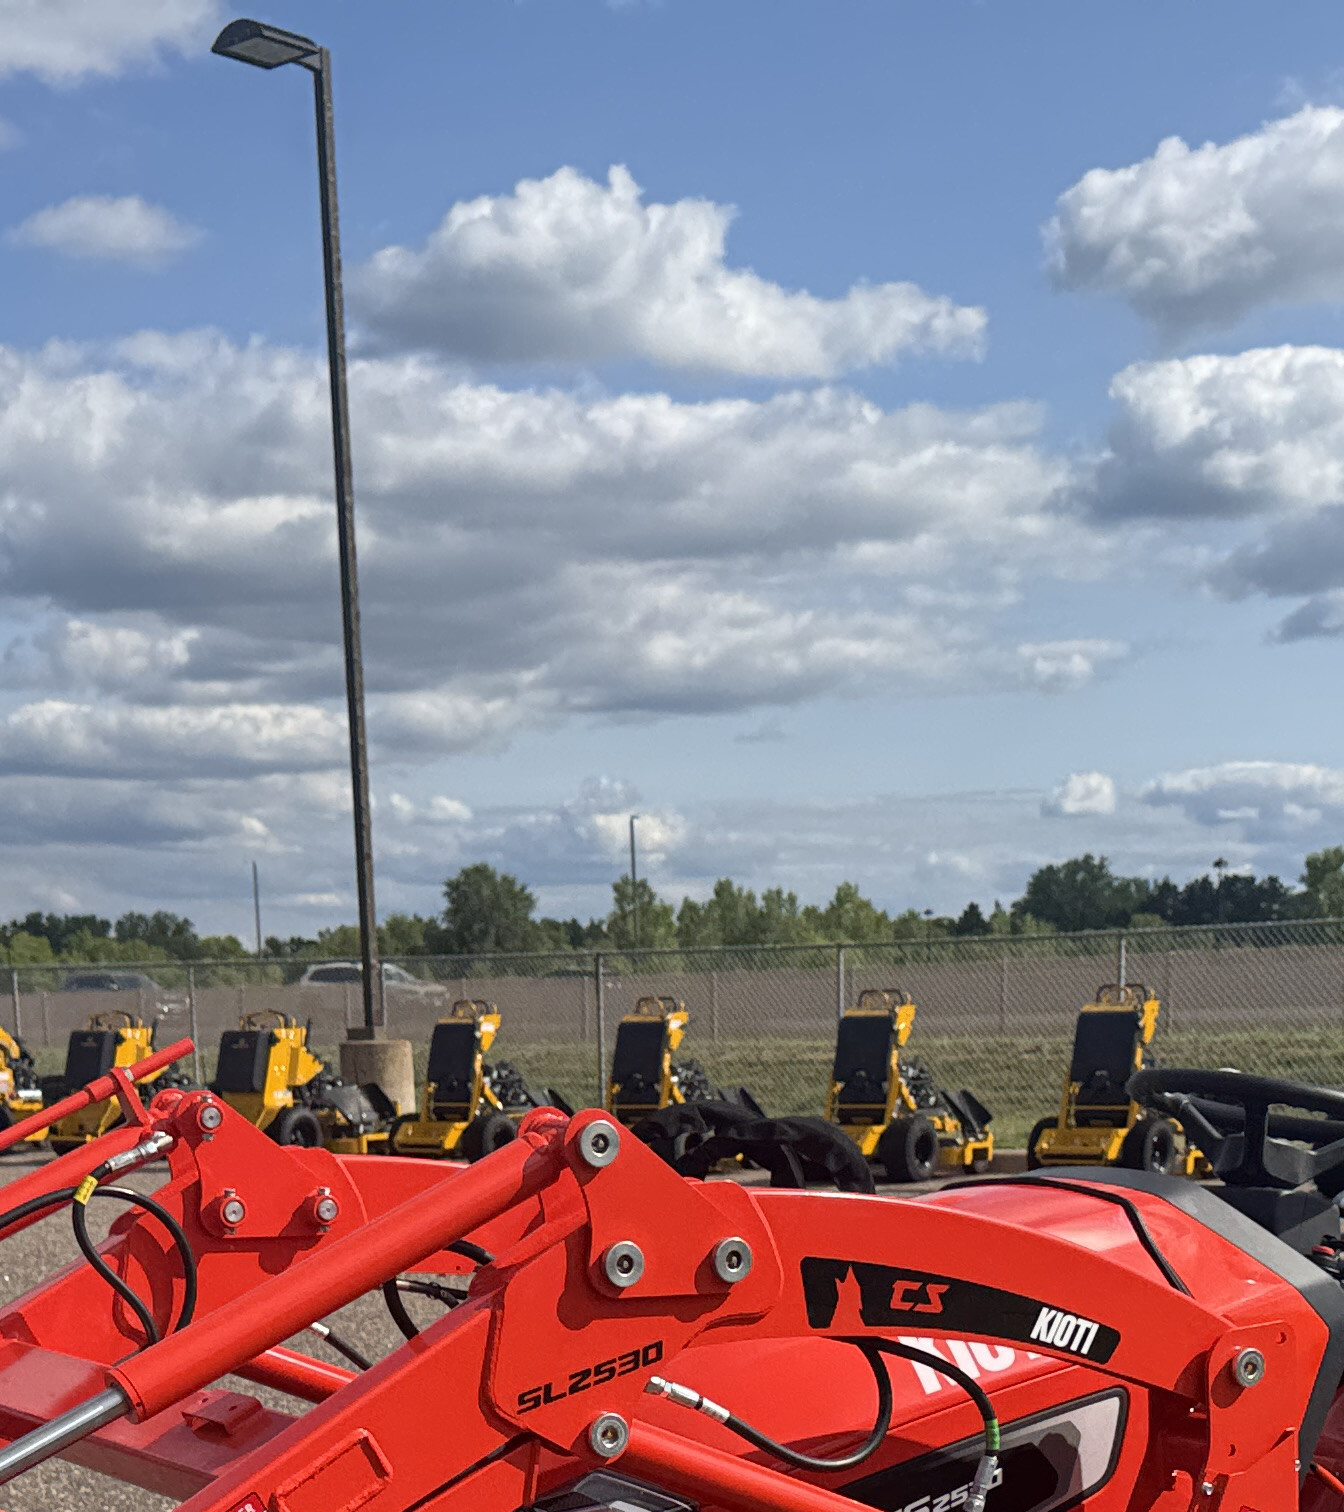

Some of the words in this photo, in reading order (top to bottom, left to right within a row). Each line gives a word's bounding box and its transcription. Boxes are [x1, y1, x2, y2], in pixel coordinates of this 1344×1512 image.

[890, 1280, 950, 1314] CS
[1030, 1307, 1099, 1355] KIOTI
[516, 1340, 664, 1415] SL2530
